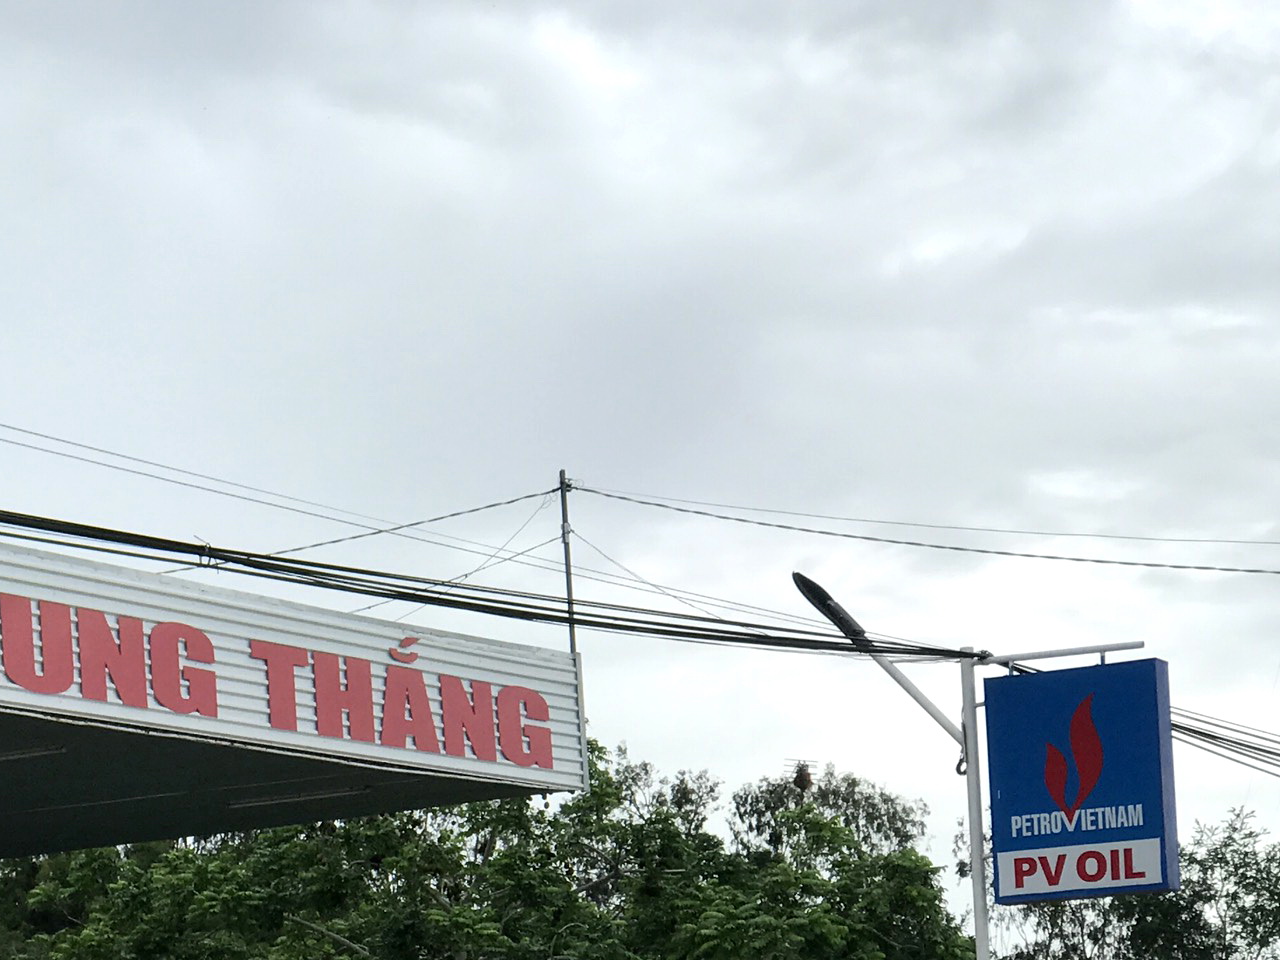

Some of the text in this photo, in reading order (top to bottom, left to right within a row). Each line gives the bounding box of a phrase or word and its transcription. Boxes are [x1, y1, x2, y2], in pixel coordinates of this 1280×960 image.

[249, 636, 555, 770] THẮNG
[1011, 804, 1144, 838] PETROVIETNAM
[1013, 848, 1146, 889] PV OIL
